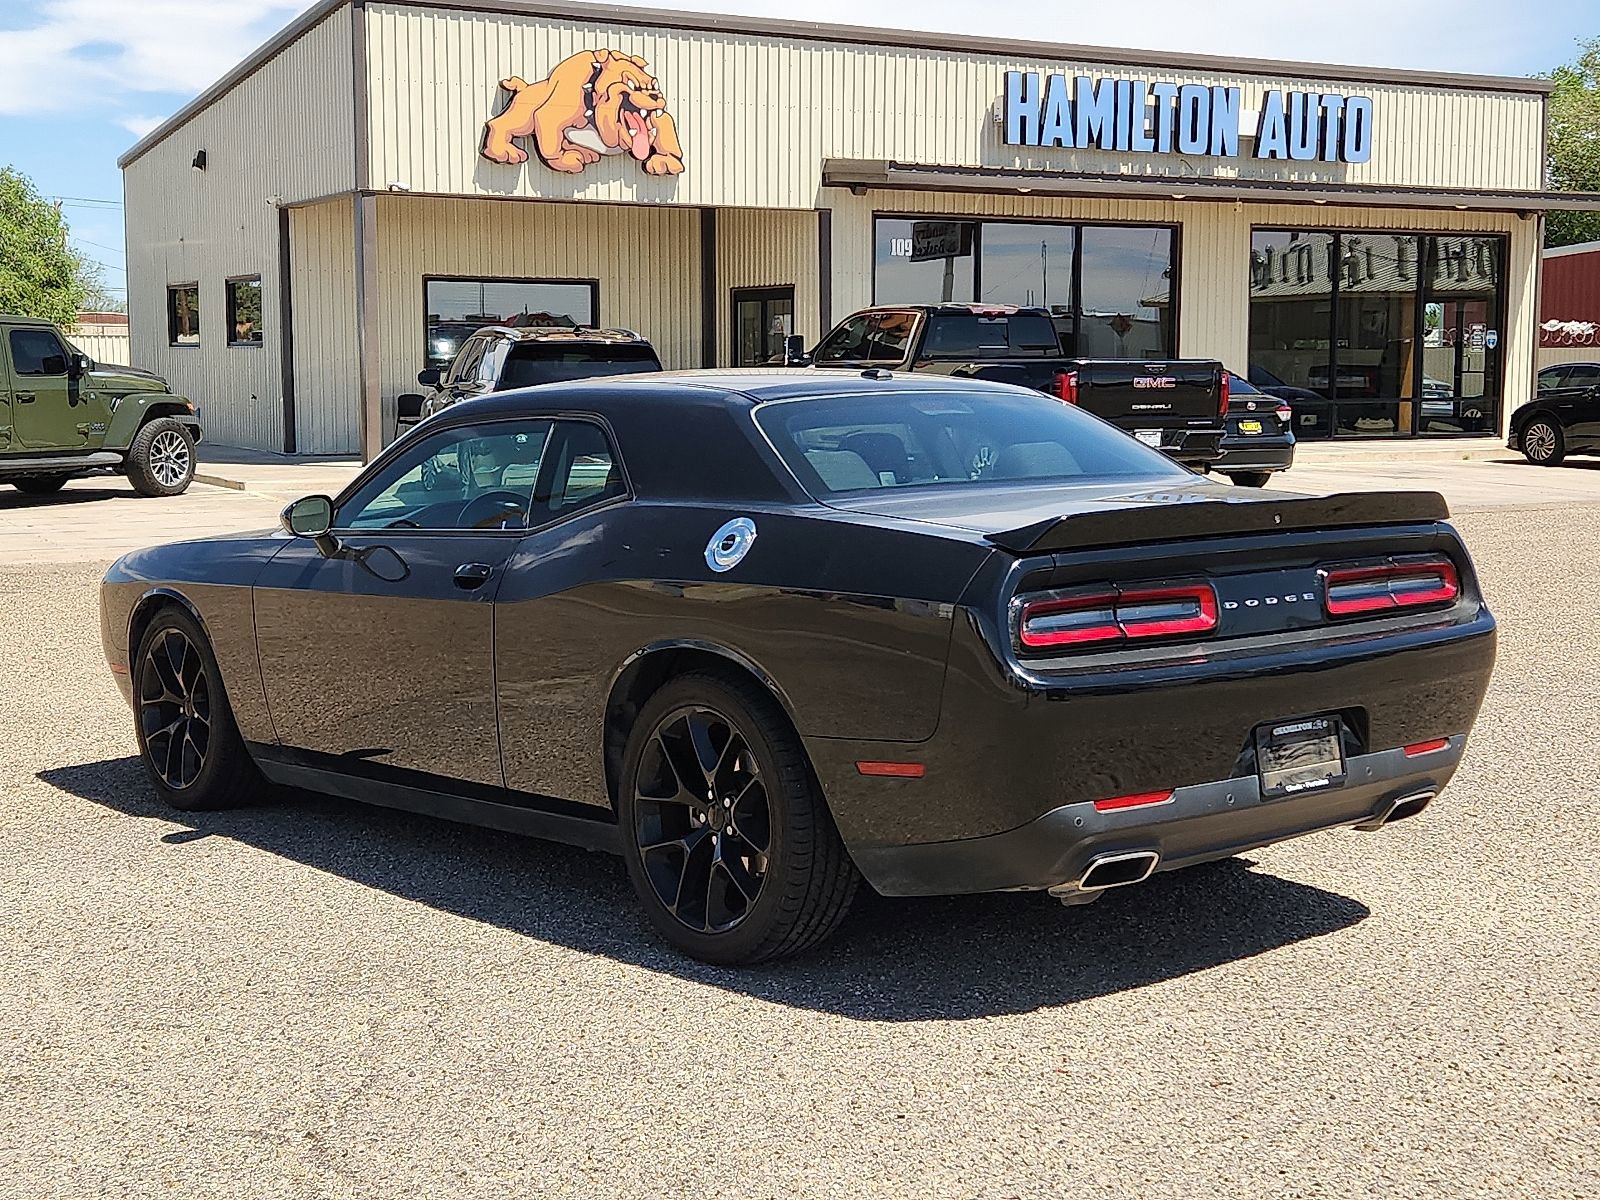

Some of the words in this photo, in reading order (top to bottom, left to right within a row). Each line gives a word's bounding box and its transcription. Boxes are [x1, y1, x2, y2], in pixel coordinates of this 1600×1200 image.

[1004, 71, 1240, 157] HAMILTON
[1253, 89, 1373, 163] AUTO
[891, 238, 913, 256] 109
[1133, 377, 1177, 388] GMC
[1223, 592, 1316, 609] DODGE
